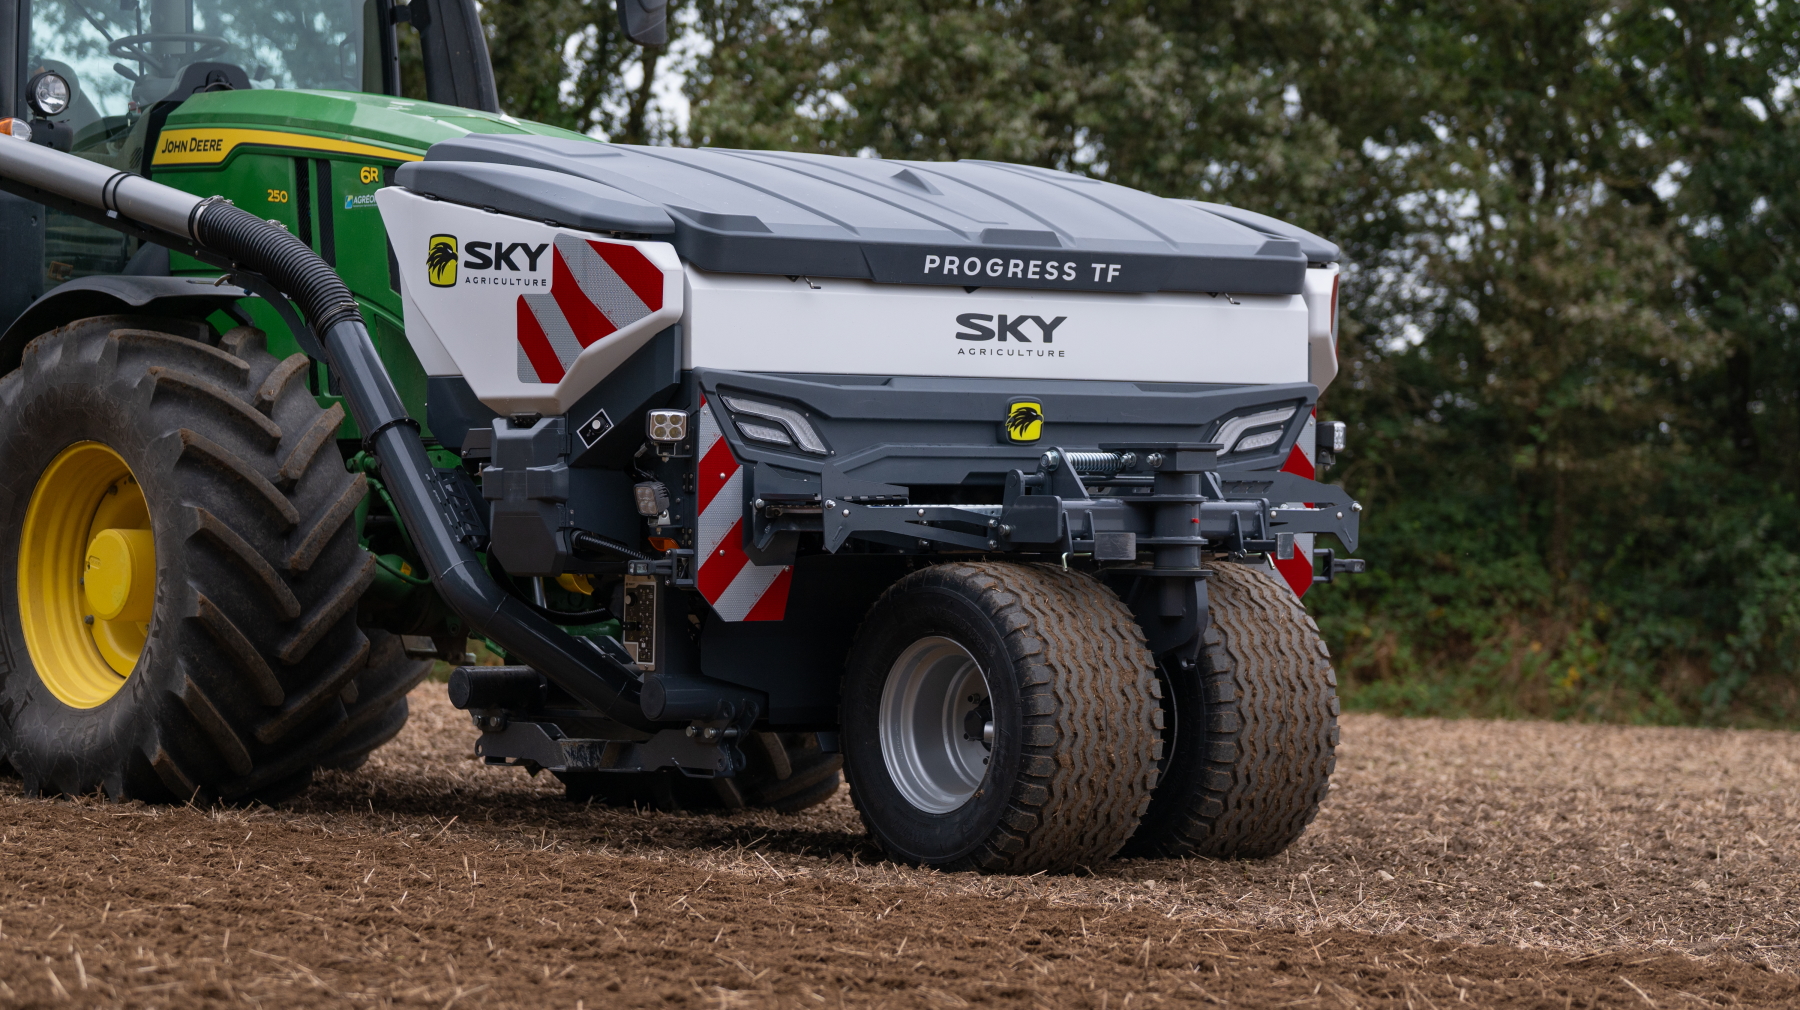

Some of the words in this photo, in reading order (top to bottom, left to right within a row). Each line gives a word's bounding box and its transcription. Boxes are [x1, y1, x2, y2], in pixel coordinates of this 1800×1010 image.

[161, 140, 188, 154] JOHN
[189, 137, 224, 153] DEERE
[360, 166, 379, 184] 6R
[267, 189, 288, 203] 250
[353, 194, 376, 205] AGRÉO
[463, 241, 549, 272] SKY
[924, 254, 1078, 282] PROGRESS
[1091, 262, 1122, 283] TF
[464, 276, 547, 287] AGRICULTURE
[955, 312, 1068, 344] SKY
[957, 347, 1065, 358] AGRICULTURE
